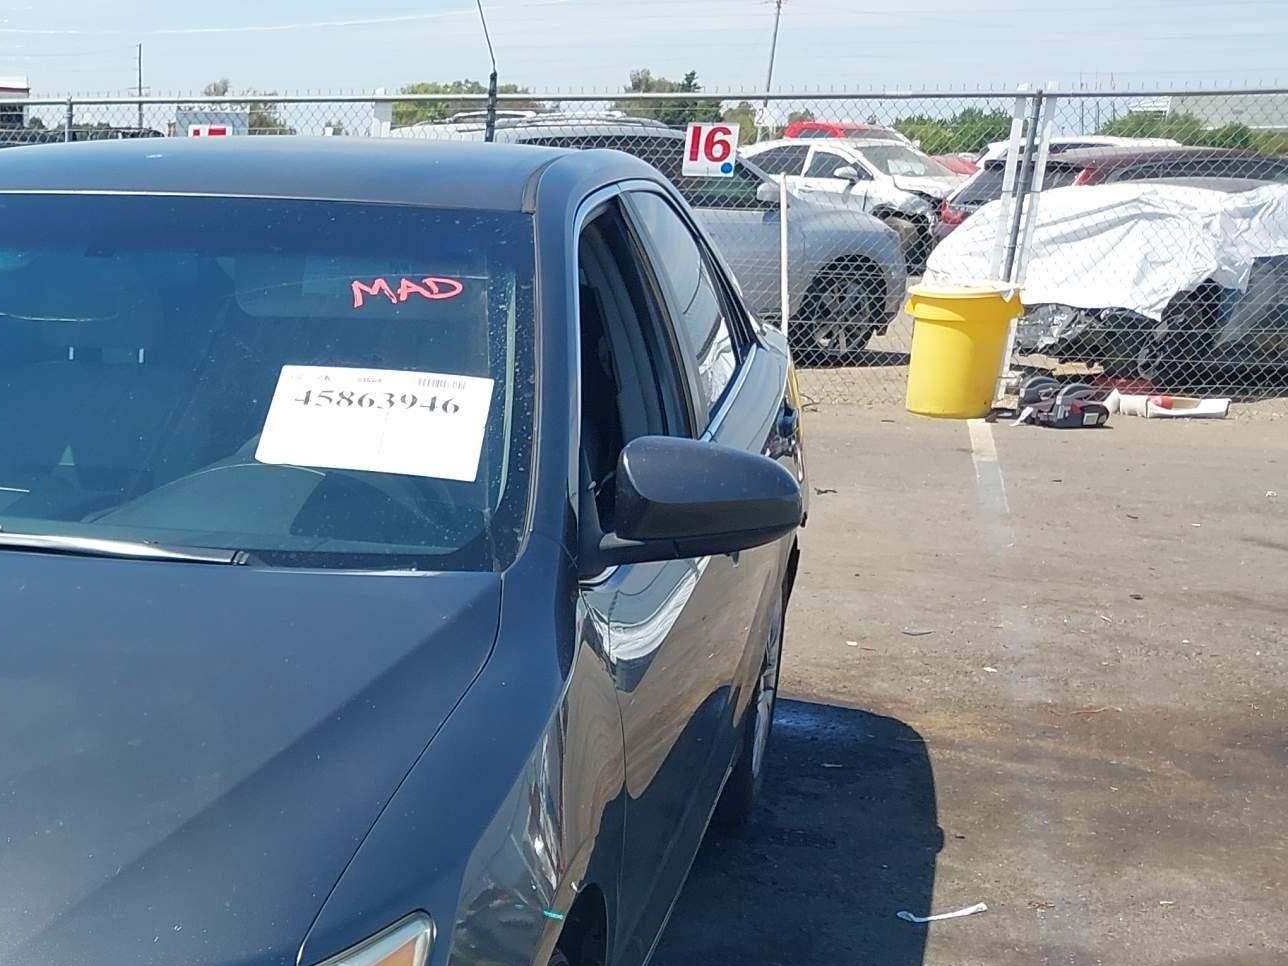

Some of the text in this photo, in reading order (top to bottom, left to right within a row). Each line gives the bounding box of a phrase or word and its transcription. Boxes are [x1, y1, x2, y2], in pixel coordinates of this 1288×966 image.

[689, 126, 732, 162] 16
[351, 277, 463, 308] MAD
[293, 389, 460, 414] 45863946
